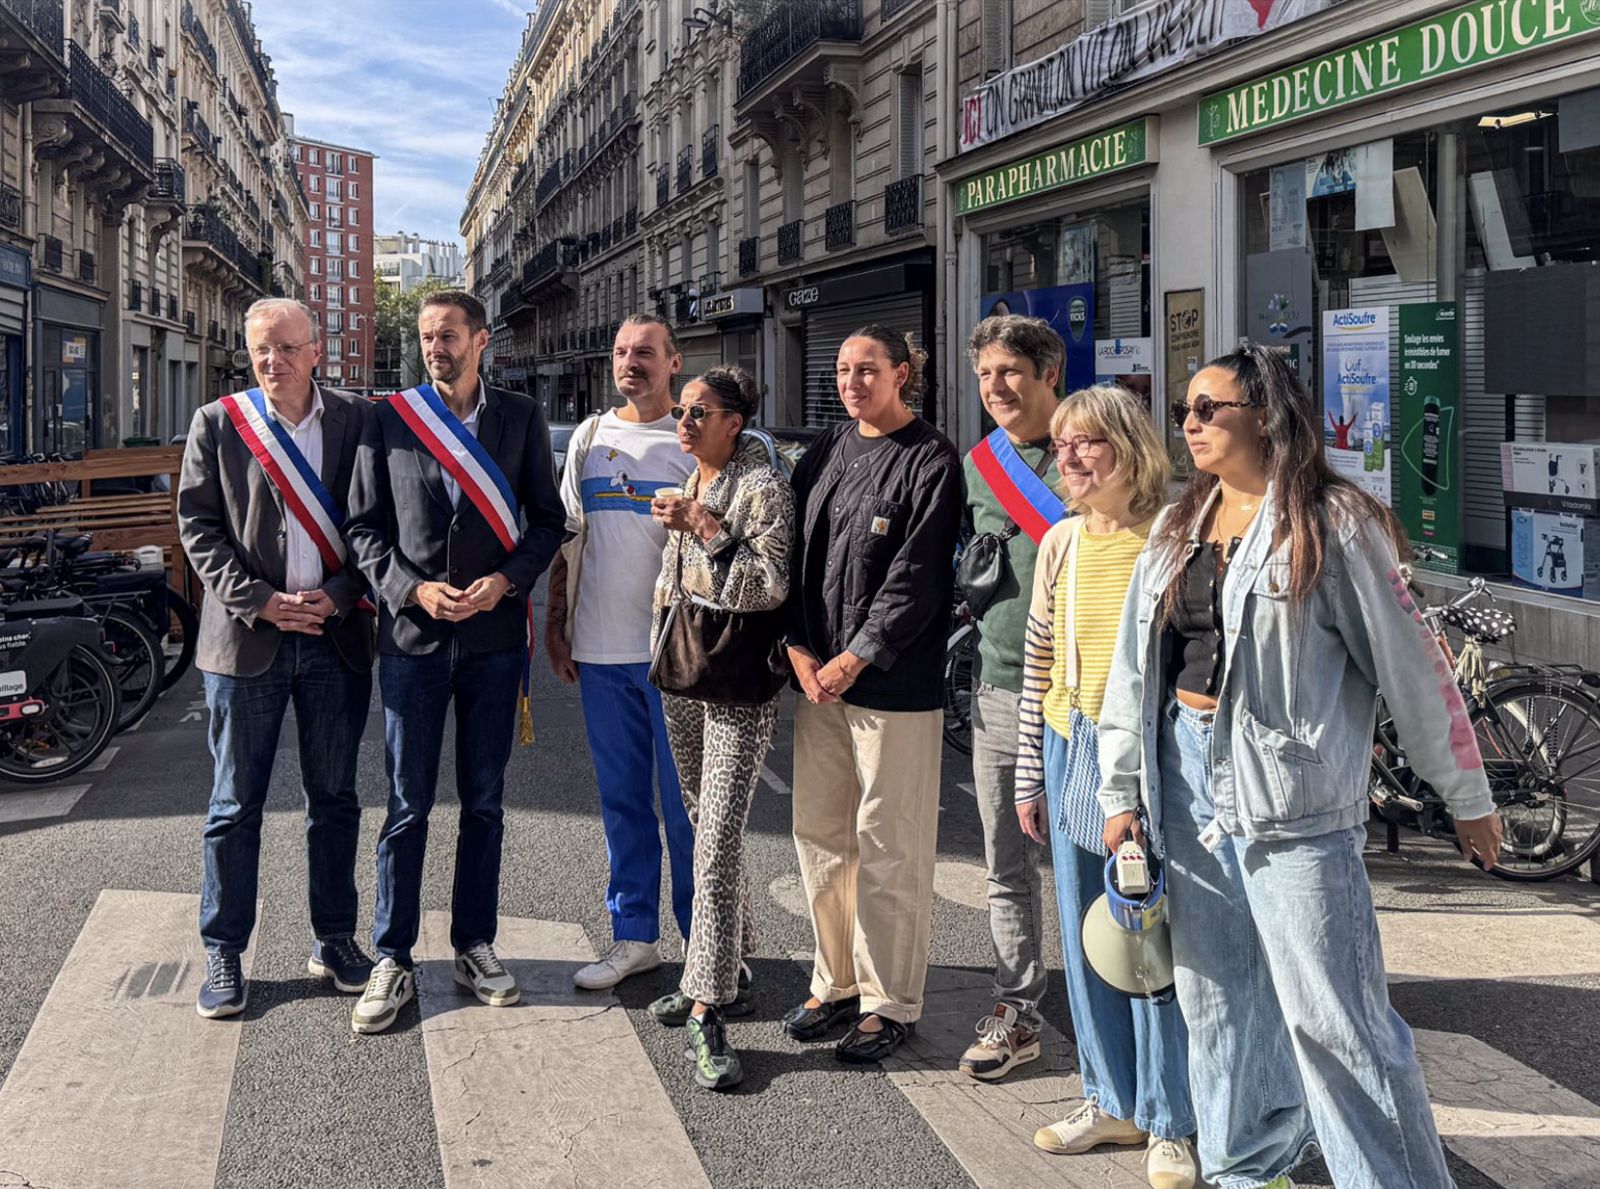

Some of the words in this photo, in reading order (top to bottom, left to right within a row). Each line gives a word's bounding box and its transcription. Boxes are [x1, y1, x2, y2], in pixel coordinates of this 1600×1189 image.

[986, 80, 1005, 136] ON
[1057, 45, 1076, 106] ON
[1226, 36, 1401, 133] MEDECINE
[1420, 0, 1572, 75] DOUCE
[967, 130, 1127, 209] PARAPHARMACIE
[1169, 308, 1199, 332] STOP
[1333, 312, 1376, 326] ActiSoufre
[1336, 372, 1377, 385] ActiSoufre
